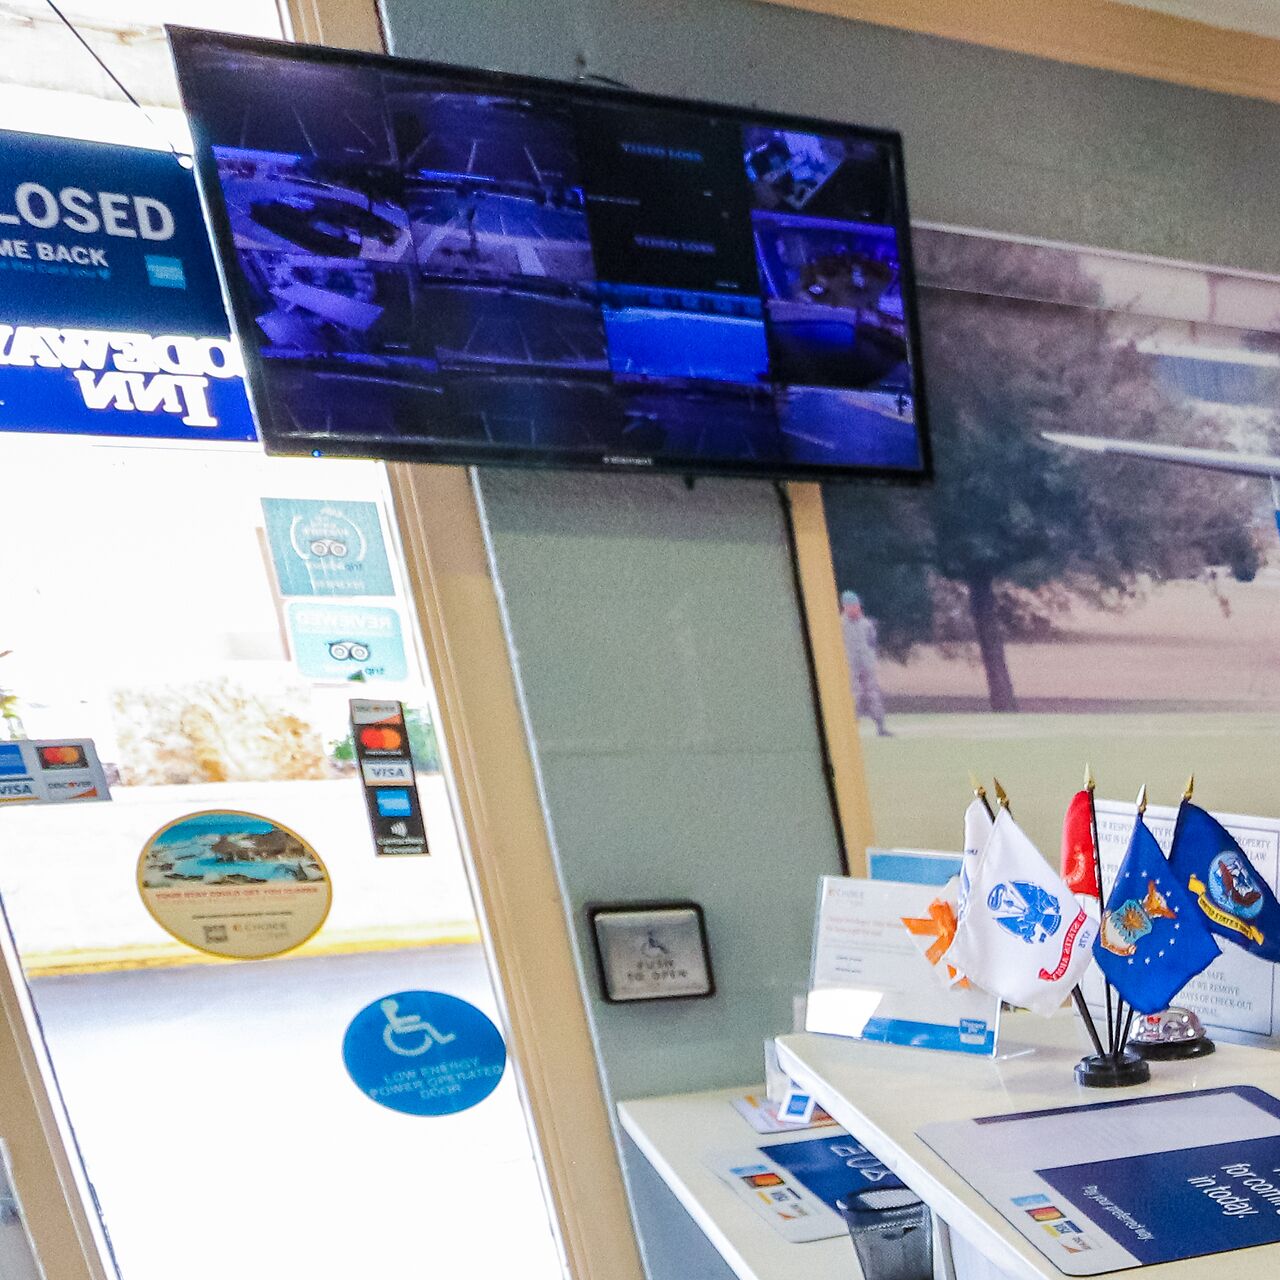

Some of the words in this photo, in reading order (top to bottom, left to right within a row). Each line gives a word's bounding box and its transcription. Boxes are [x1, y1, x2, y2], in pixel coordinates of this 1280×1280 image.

[0, 181, 176, 241] OSED
[35, 241, 109, 267] BACK
[371, 768, 406, 777] VISA
[1220, 1162, 1256, 1180] for
[1187, 1174, 1216, 1188] in
[1202, 1185, 1260, 1219] today.
